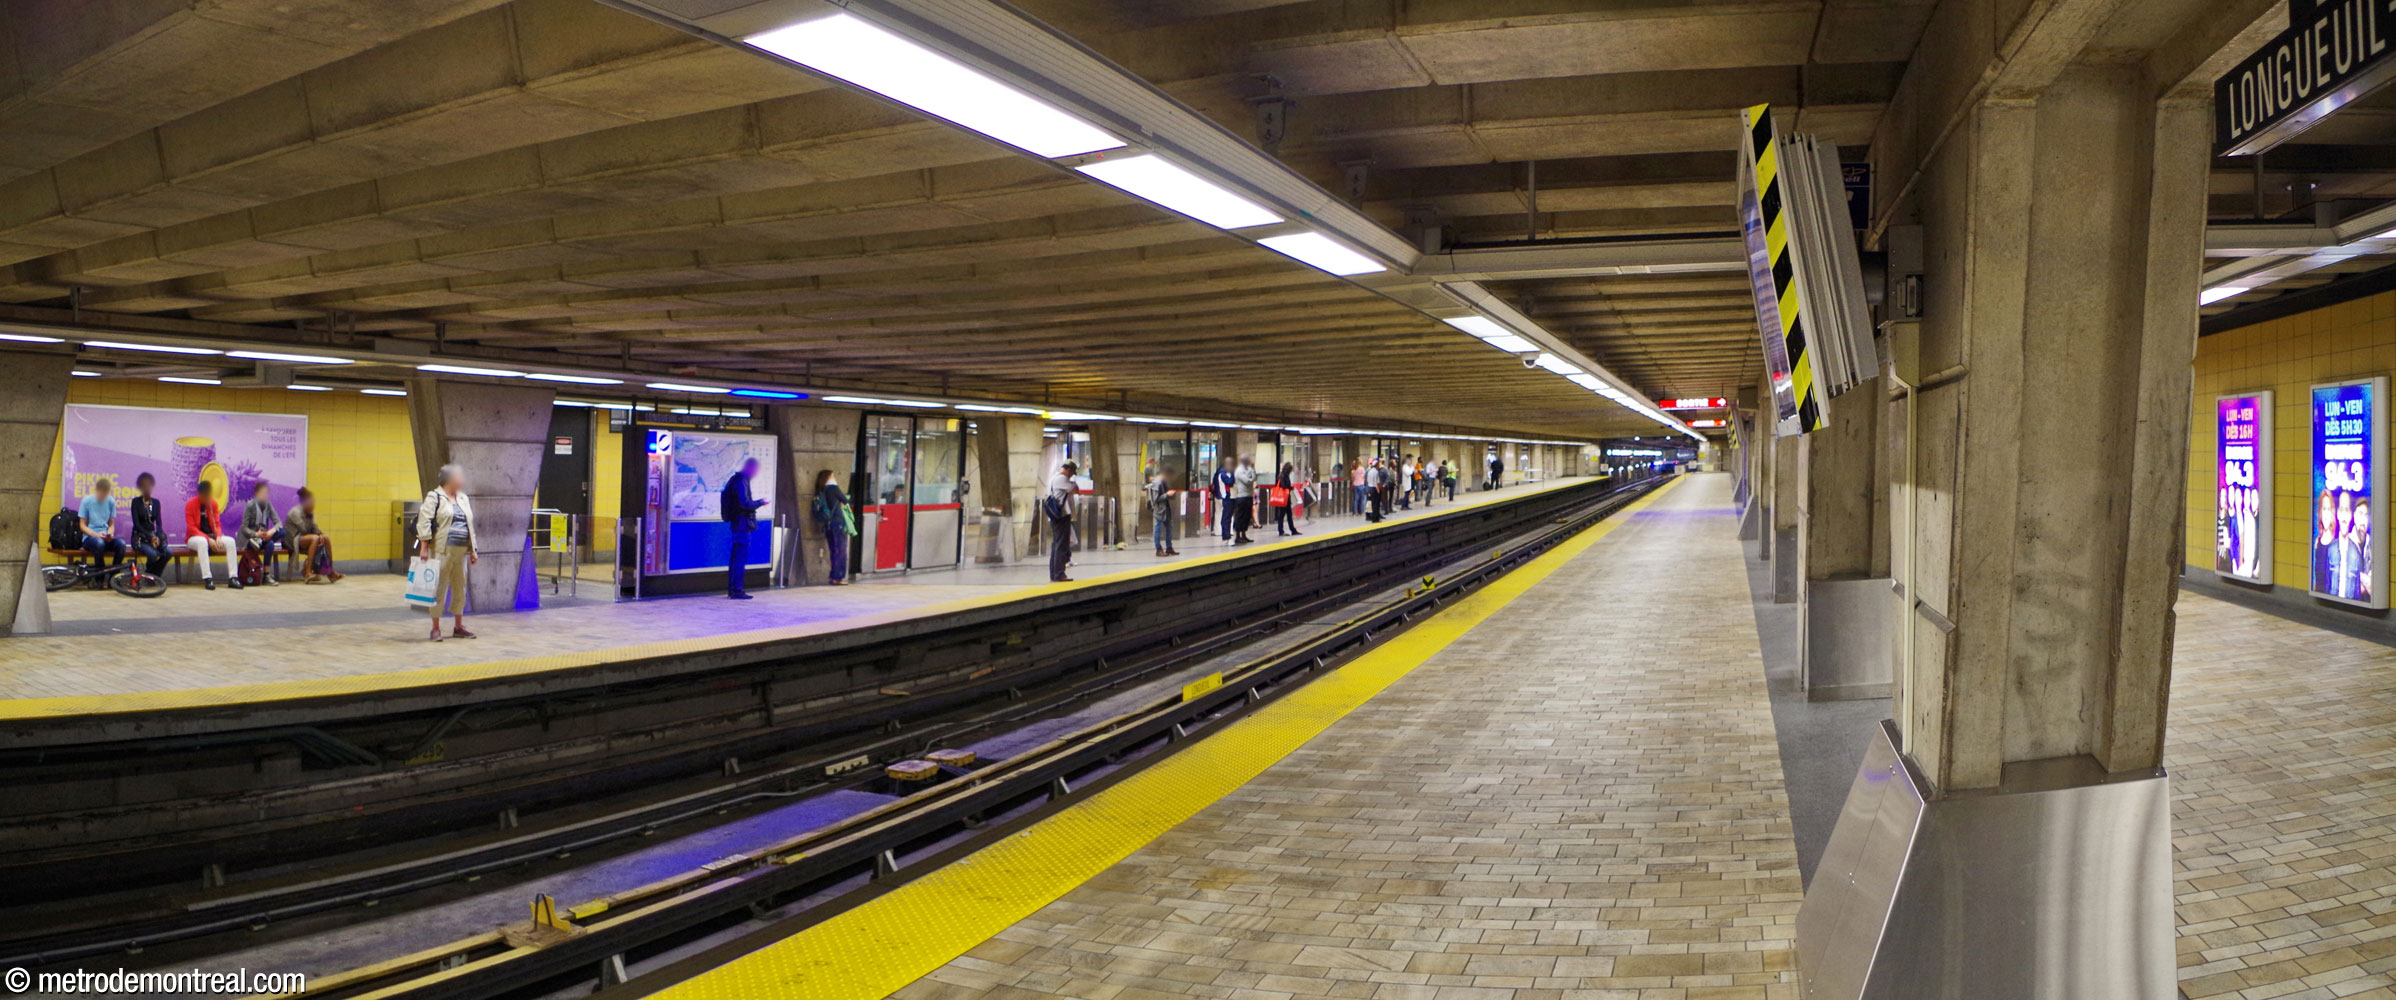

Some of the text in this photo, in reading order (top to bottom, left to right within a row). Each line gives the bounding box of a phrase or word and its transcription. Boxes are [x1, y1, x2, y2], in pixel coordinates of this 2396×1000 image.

[2226, 422, 2238, 439] DÈS
[2325, 417, 2363, 436] DÈS 5H30
[2324, 461, 2364, 492] 94.3
